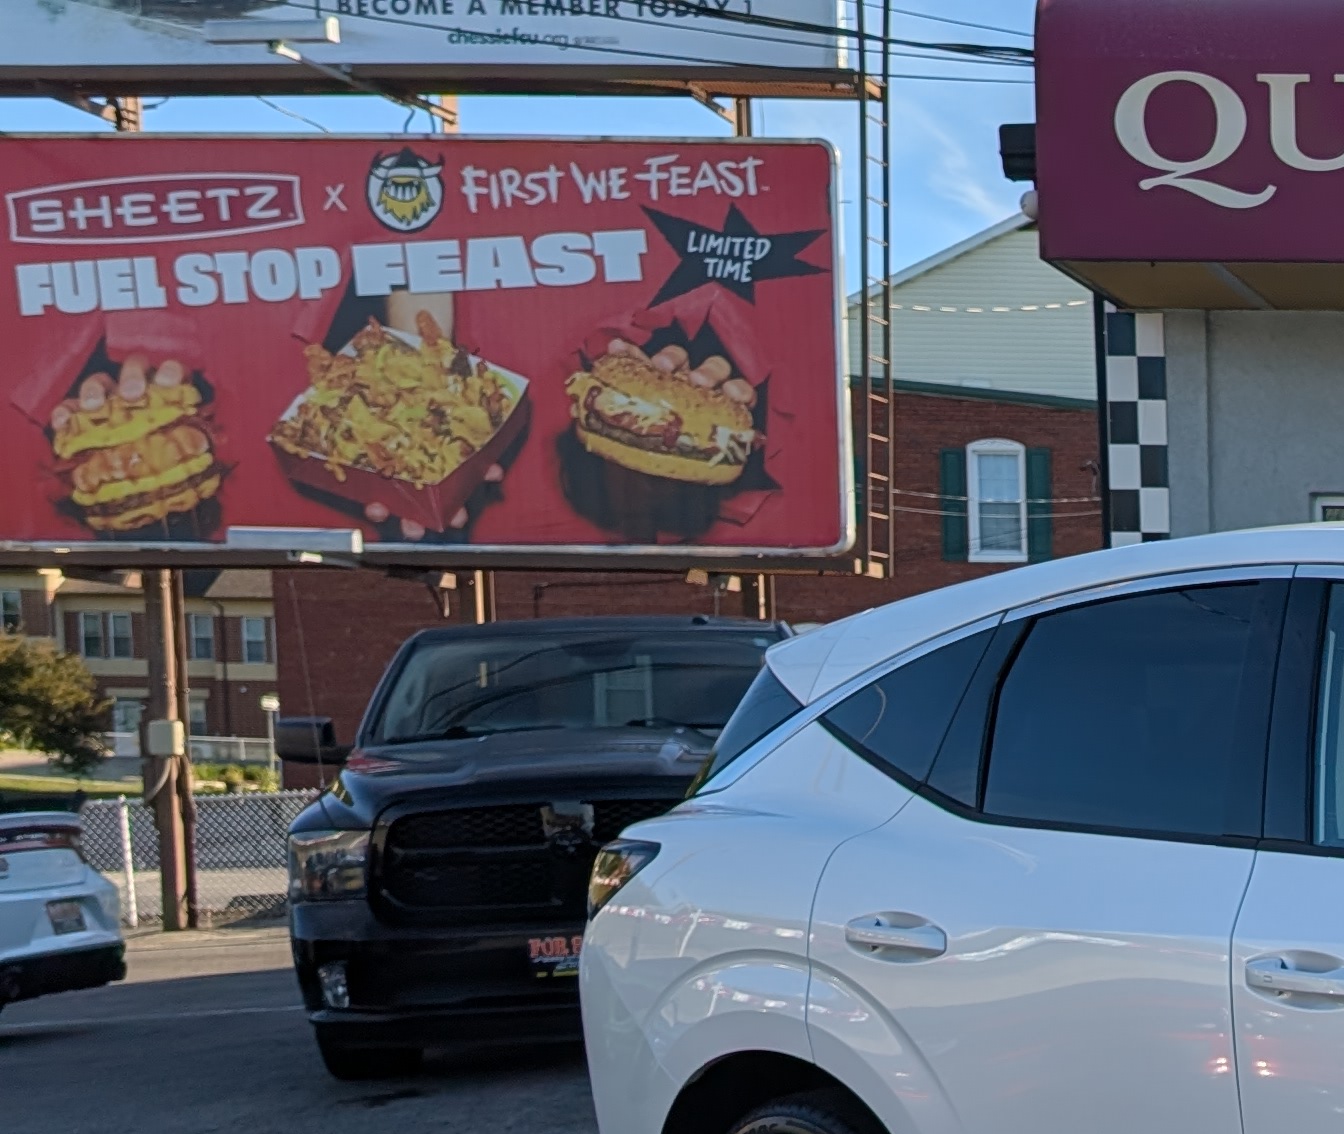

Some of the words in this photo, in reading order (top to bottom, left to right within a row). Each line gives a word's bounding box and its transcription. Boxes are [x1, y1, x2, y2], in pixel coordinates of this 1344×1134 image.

[336, 0, 454, 15] BECOME
[466, 0, 487, 15] A
[500, 0, 619, 17] MEMBER
[29, 185, 283, 233] SHEETZ
[460, 163, 565, 213] FIRST
[570, 162, 631, 204] WE
[634, 154, 765, 201] FEAST
[687, 231, 771, 261] LIMITED
[15, 256, 168, 316] FUEL
[173, 247, 342, 306] STOP
[352, 229, 648, 297] FEAST
[704, 257, 753, 283] TIME
[528, 936, 569, 958] FOR
